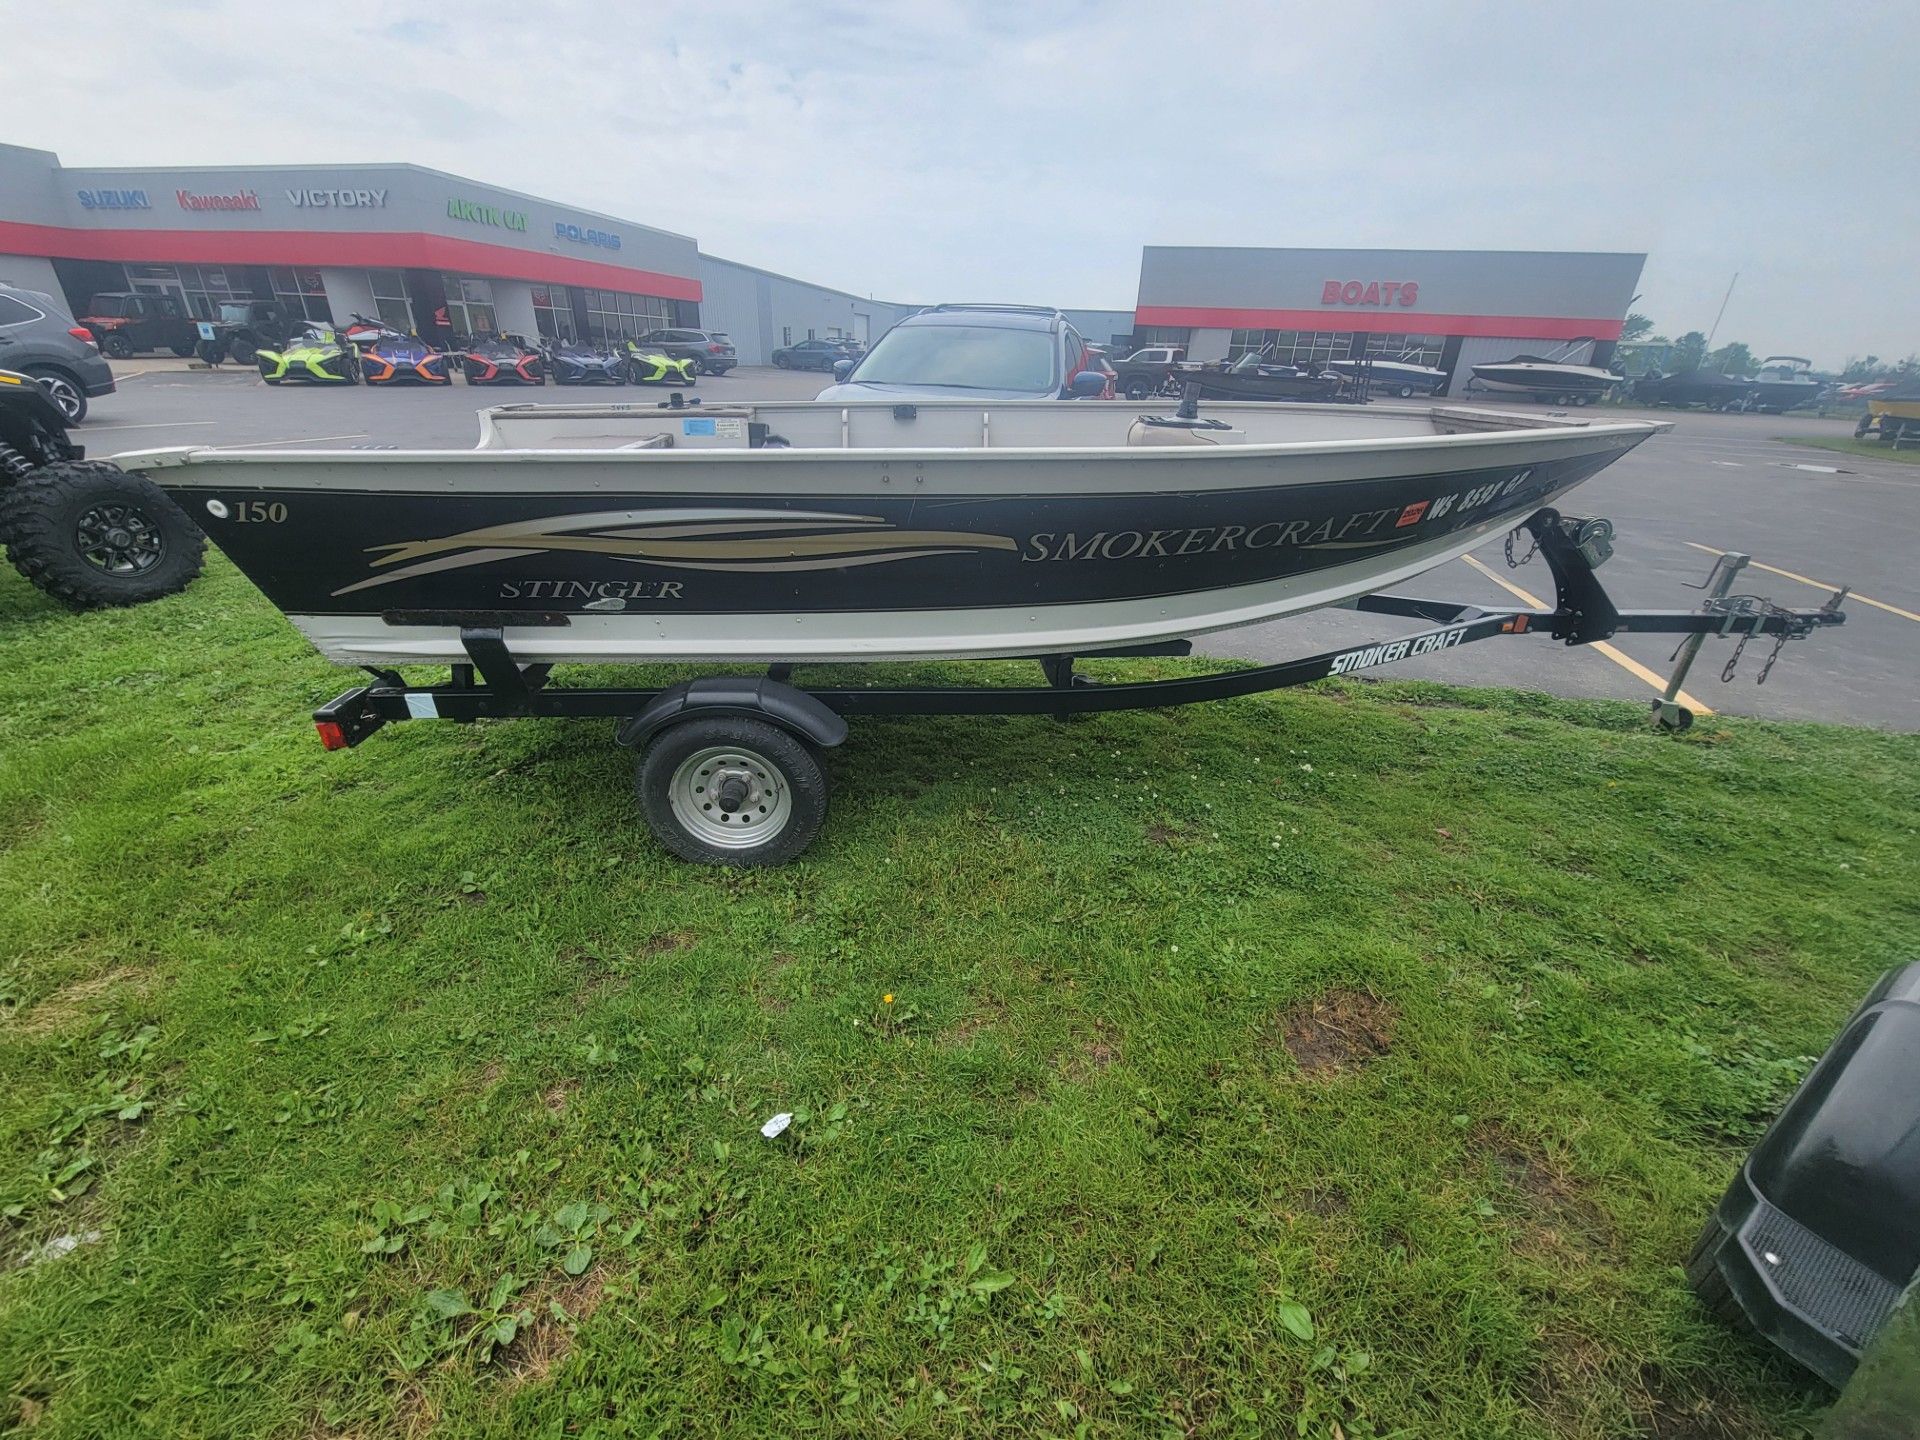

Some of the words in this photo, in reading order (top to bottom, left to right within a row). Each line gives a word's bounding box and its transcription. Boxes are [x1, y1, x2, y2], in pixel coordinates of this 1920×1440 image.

[77, 190, 151, 209] SUZUKI
[176, 190, 262, 211] Kawasaki
[286, 189, 388, 209] VICTORY
[447, 199, 500, 228] ARCTIC
[502, 208, 529, 233] CAT
[554, 222, 622, 250] POLARIS
[1321, 280, 1419, 306] BOATS
[233, 501, 289, 524] 150
[1426, 493, 1459, 521] WS
[1021, 508, 1400, 563] SMOKERCRAFT
[499, 580, 684, 601] STINGER
[1327, 641, 1411, 677] SMOKER
[1410, 628, 1468, 657] CRAFT
